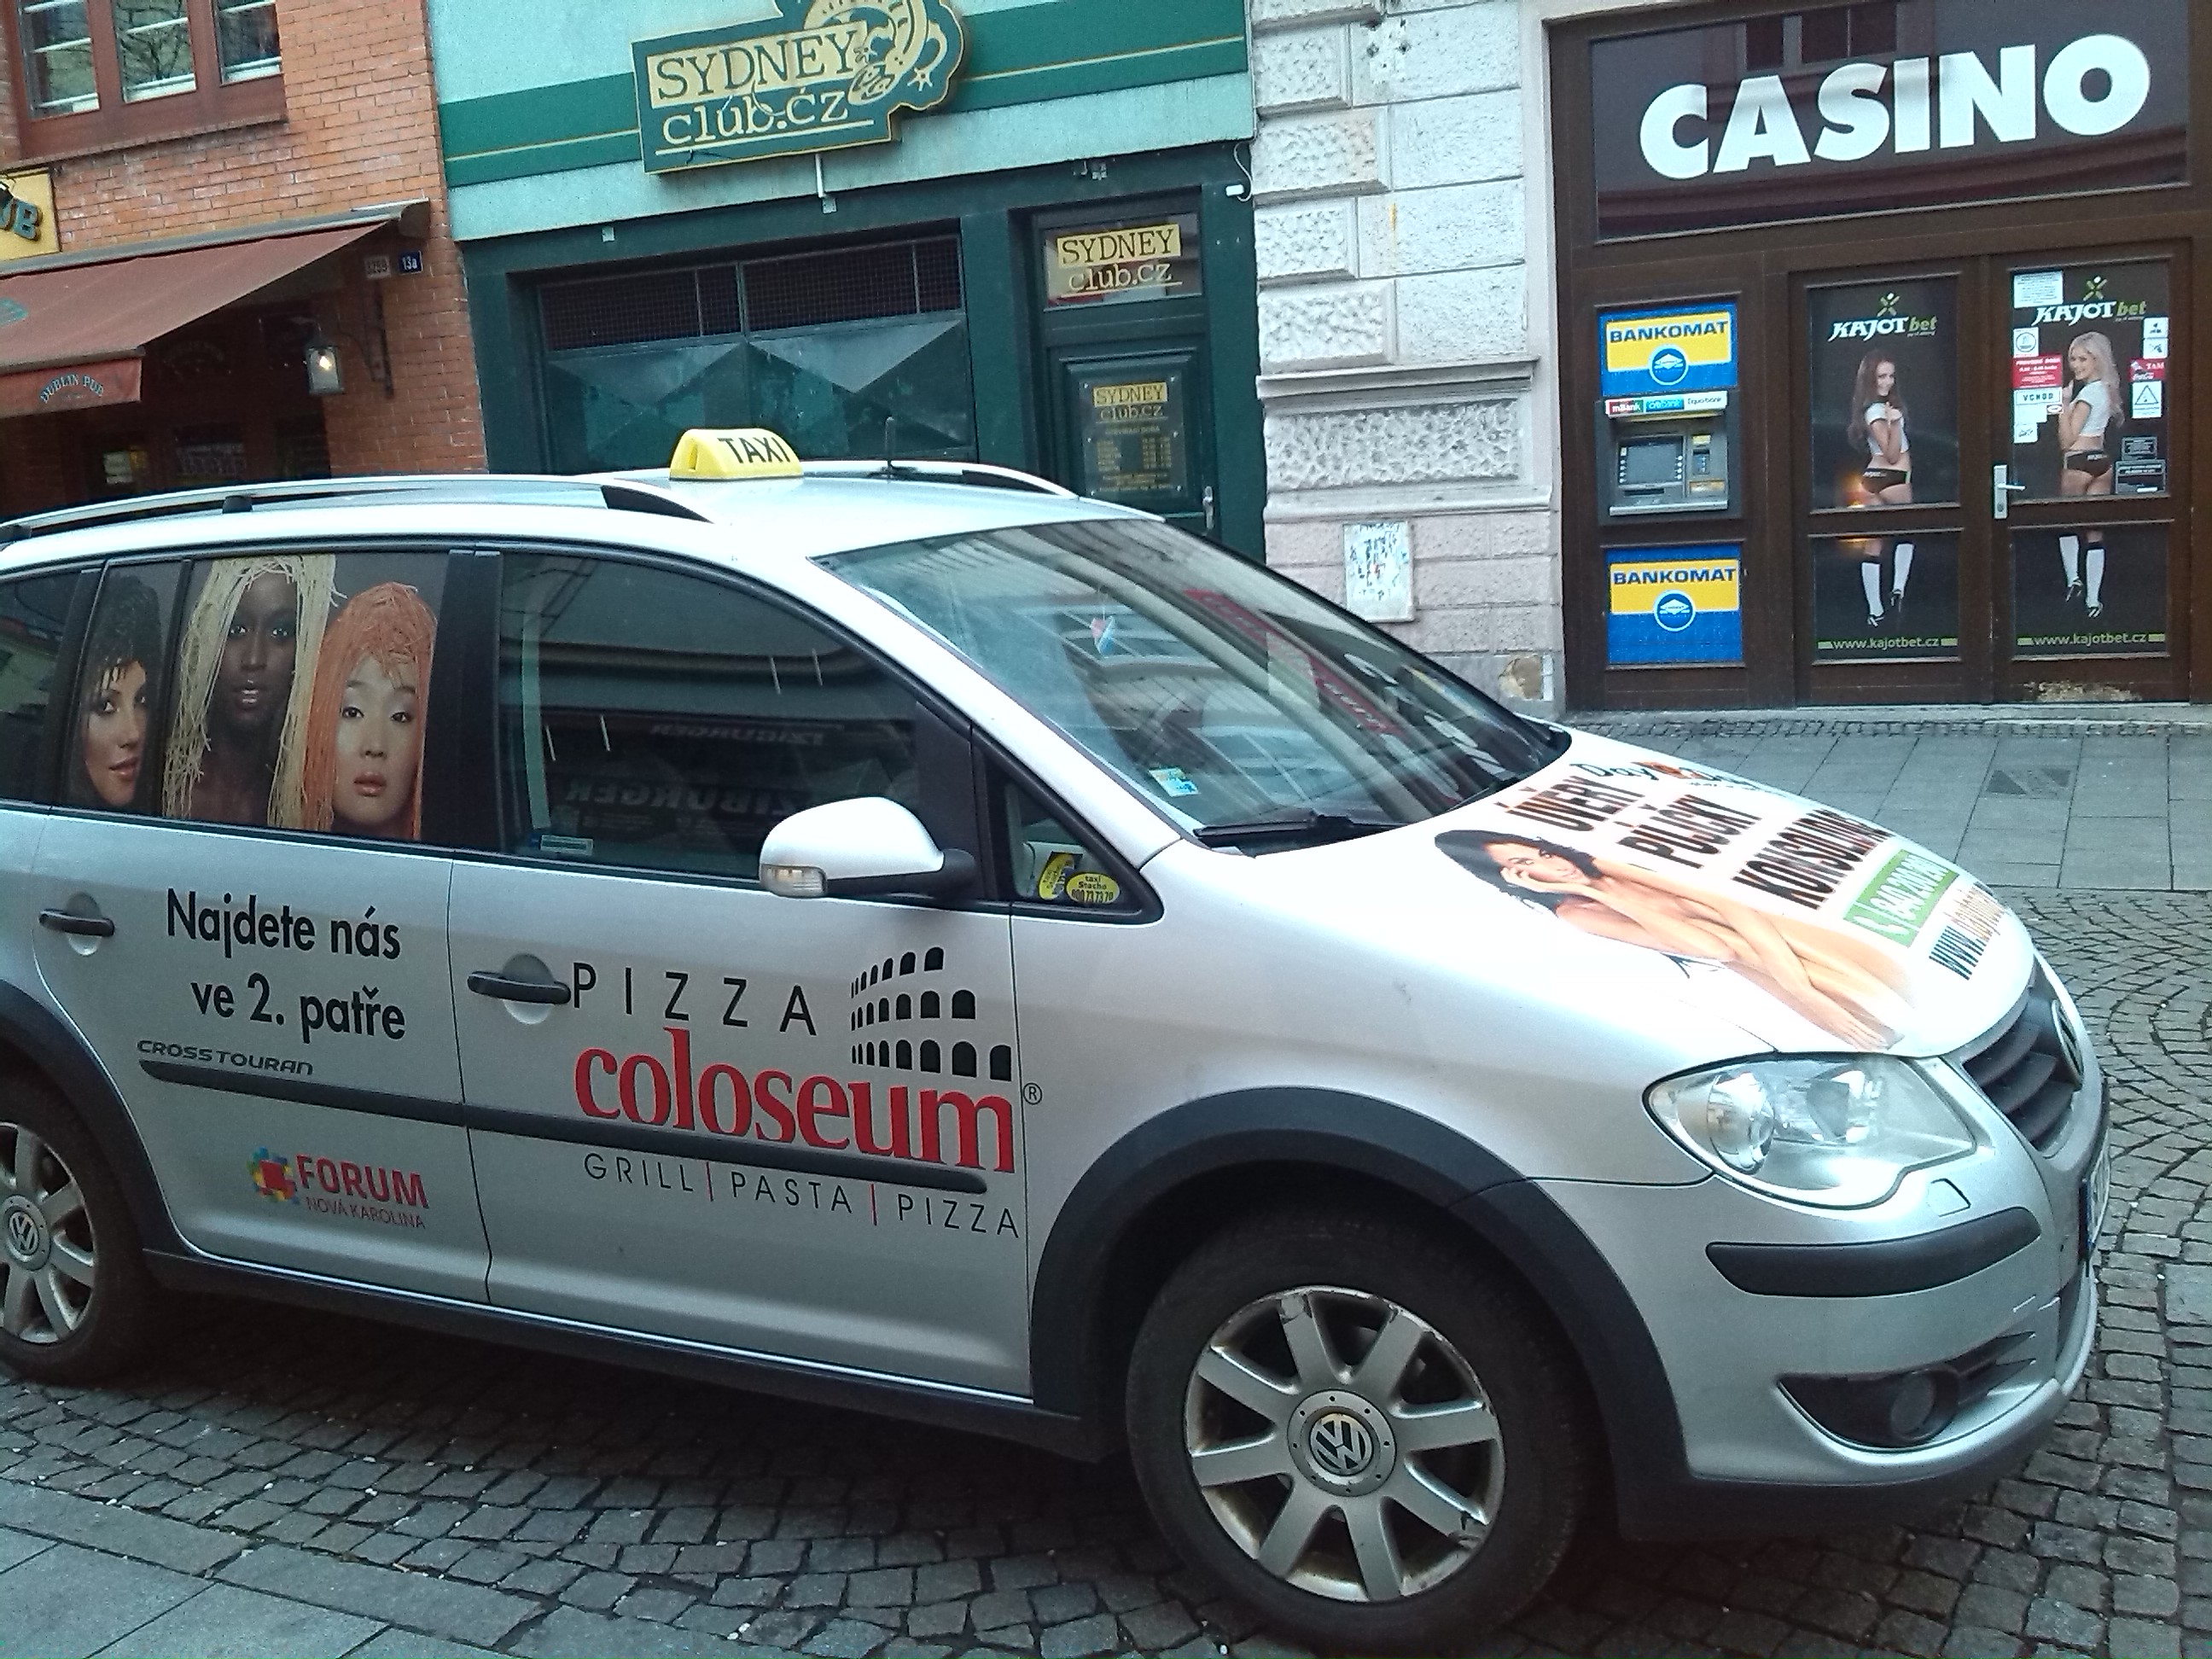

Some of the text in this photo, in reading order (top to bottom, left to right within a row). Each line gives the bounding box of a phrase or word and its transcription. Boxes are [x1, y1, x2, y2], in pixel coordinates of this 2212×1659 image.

[656, 30, 858, 100] SYDNEY
[662, 90, 848, 144] club.cz
[1640, 34, 2150, 180] CASINO
[1062, 228, 1173, 264] SYDNEY
[1069, 263, 1172, 291] club.cz
[1827, 316, 1938, 341] KAJOT bet
[2031, 300, 2147, 327] KAJOT bet
[1610, 321, 1728, 343] BANKOMAT
[1096, 384, 1163, 404] SYDNEY
[2023, 393, 2054, 402] VCHOD
[717, 437, 791, 463] TAXI
[1613, 568, 1737, 585] BANKOMAT
[1834, 637, 1940, 651] www.kajotbet.cz
[2034, 632, 2148, 647] www.kajotbet.cz
[1493, 775, 1645, 832] ÚVĚRY
[166, 888, 401, 961] Najdete nás
[191, 973, 406, 1044] ve 2. patře
[573, 963, 817, 1037] PIZZA
[574, 1027, 1016, 1173] coloseum
[296, 1154, 430, 1209] FORUM
[584, 1153, 1020, 1238] GRILL PASTA PIZZA
[349, 1205, 427, 1229] KAROLINA
